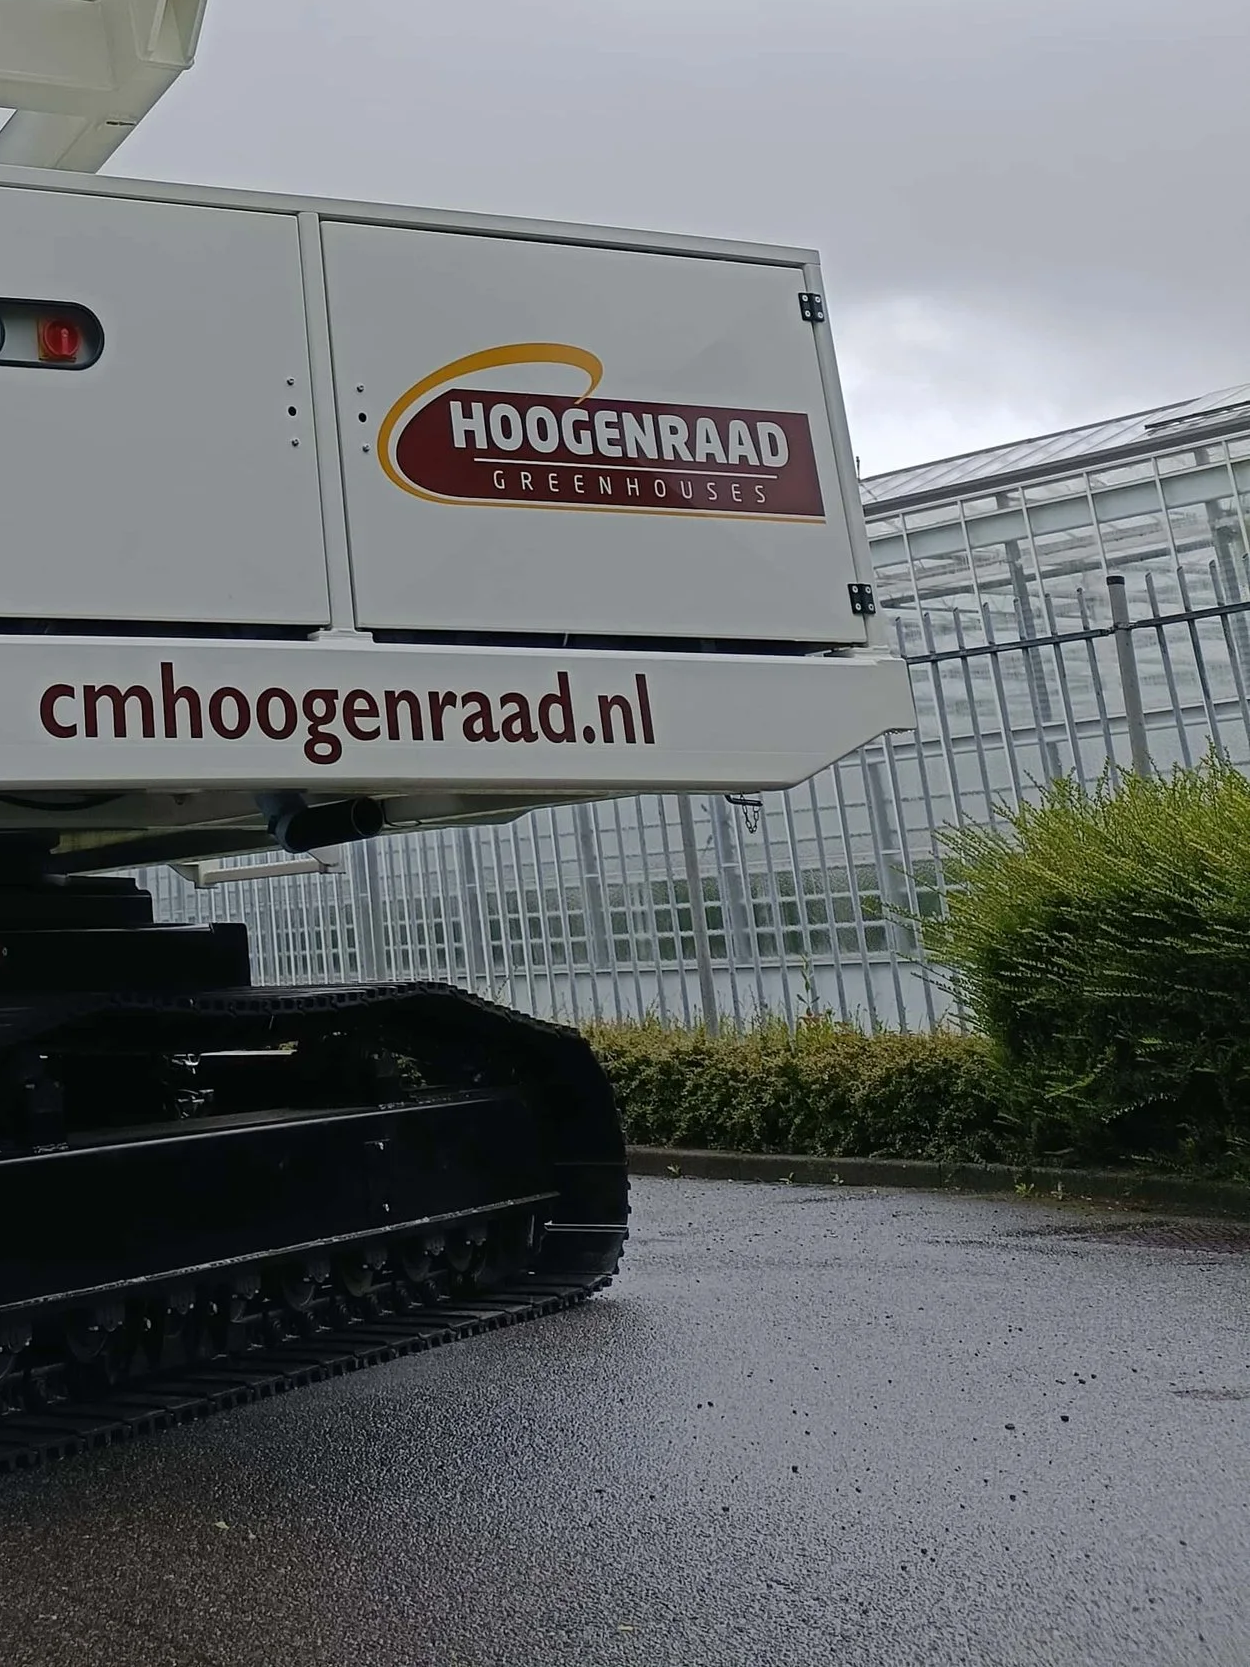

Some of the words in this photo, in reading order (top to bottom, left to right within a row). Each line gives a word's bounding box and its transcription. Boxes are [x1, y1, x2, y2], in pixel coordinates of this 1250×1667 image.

[449, 400, 789, 469] HOOGENRAAD
[493, 470, 767, 503] GREENHOUSES
[39, 661, 656, 765] cmhoogenraad.nl
